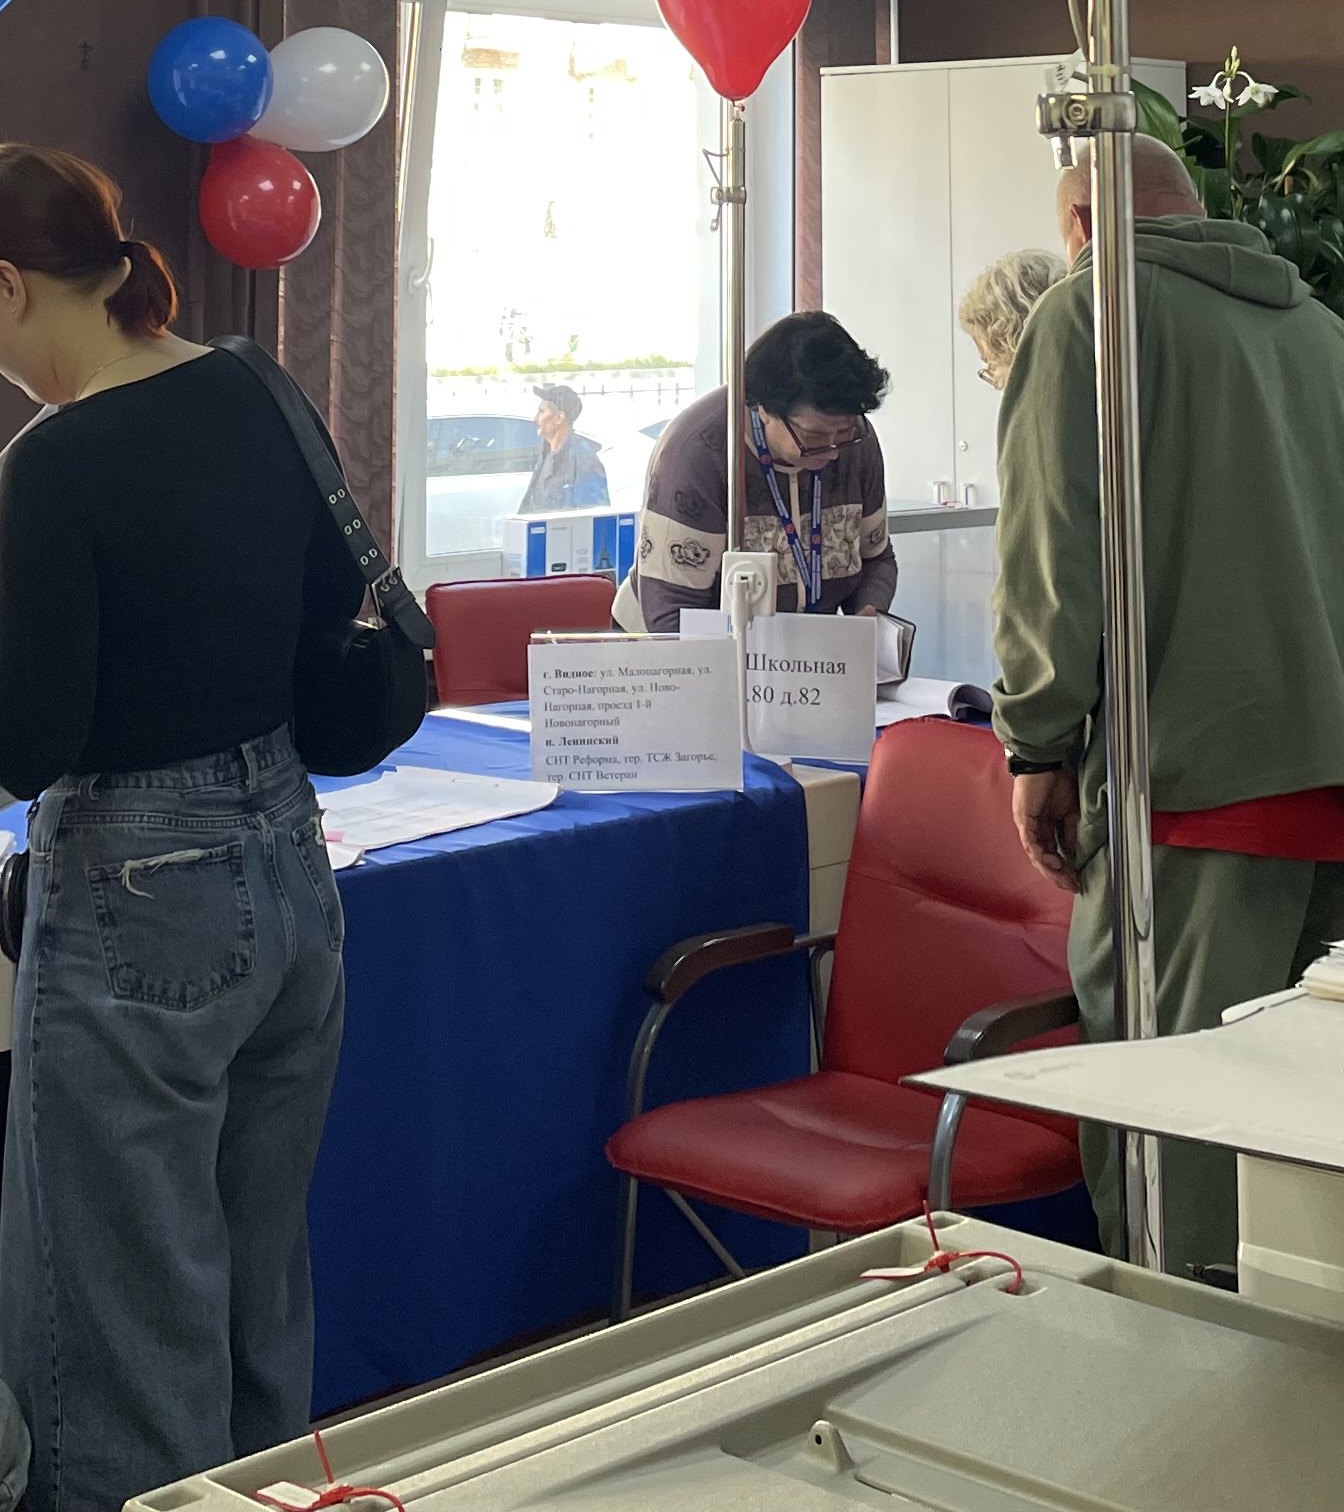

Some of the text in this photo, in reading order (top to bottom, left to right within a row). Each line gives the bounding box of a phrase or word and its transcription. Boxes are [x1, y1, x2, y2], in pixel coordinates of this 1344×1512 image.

[746, 652, 847, 675] Школьная
[779, 687, 822, 709] д.82
[558, 735, 620, 747] Ленинский
[545, 755, 571, 766] СНТ
[568, 771, 593, 781] СНТ
